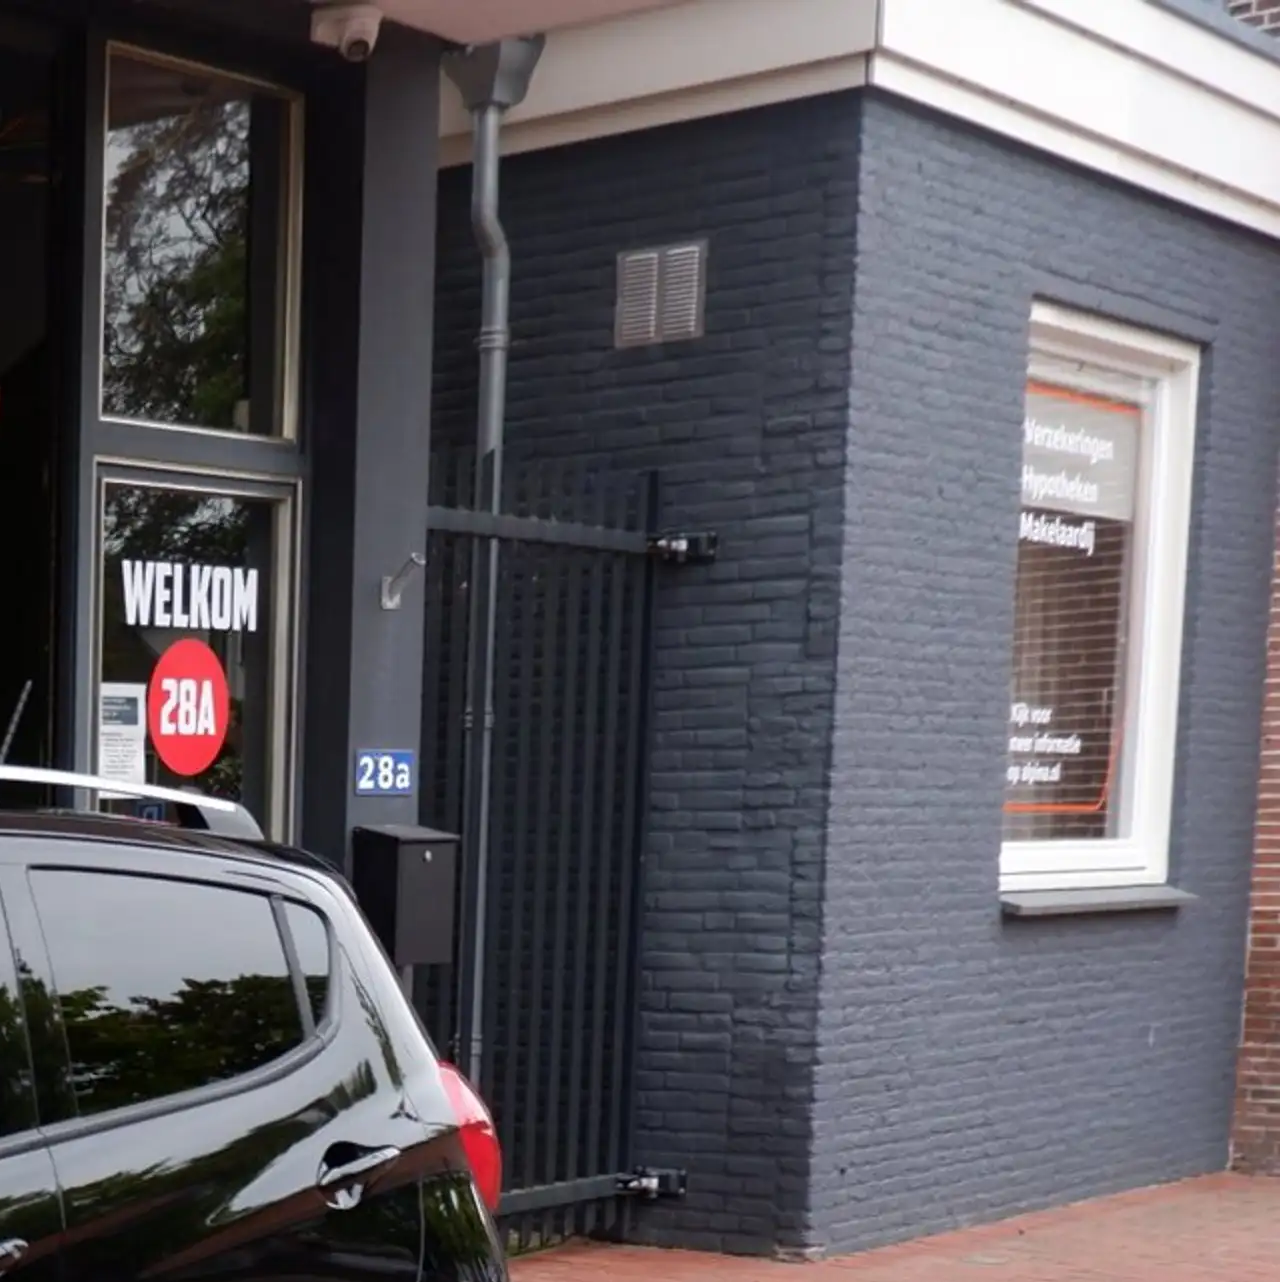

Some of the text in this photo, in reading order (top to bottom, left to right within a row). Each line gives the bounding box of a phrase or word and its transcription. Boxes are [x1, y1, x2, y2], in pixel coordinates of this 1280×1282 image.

[1019, 512, 1096, 556] Makelaardij
[121, 559, 259, 632] WELKOM
[159, 678, 217, 736] 28A
[357, 755, 411, 790] 28a
